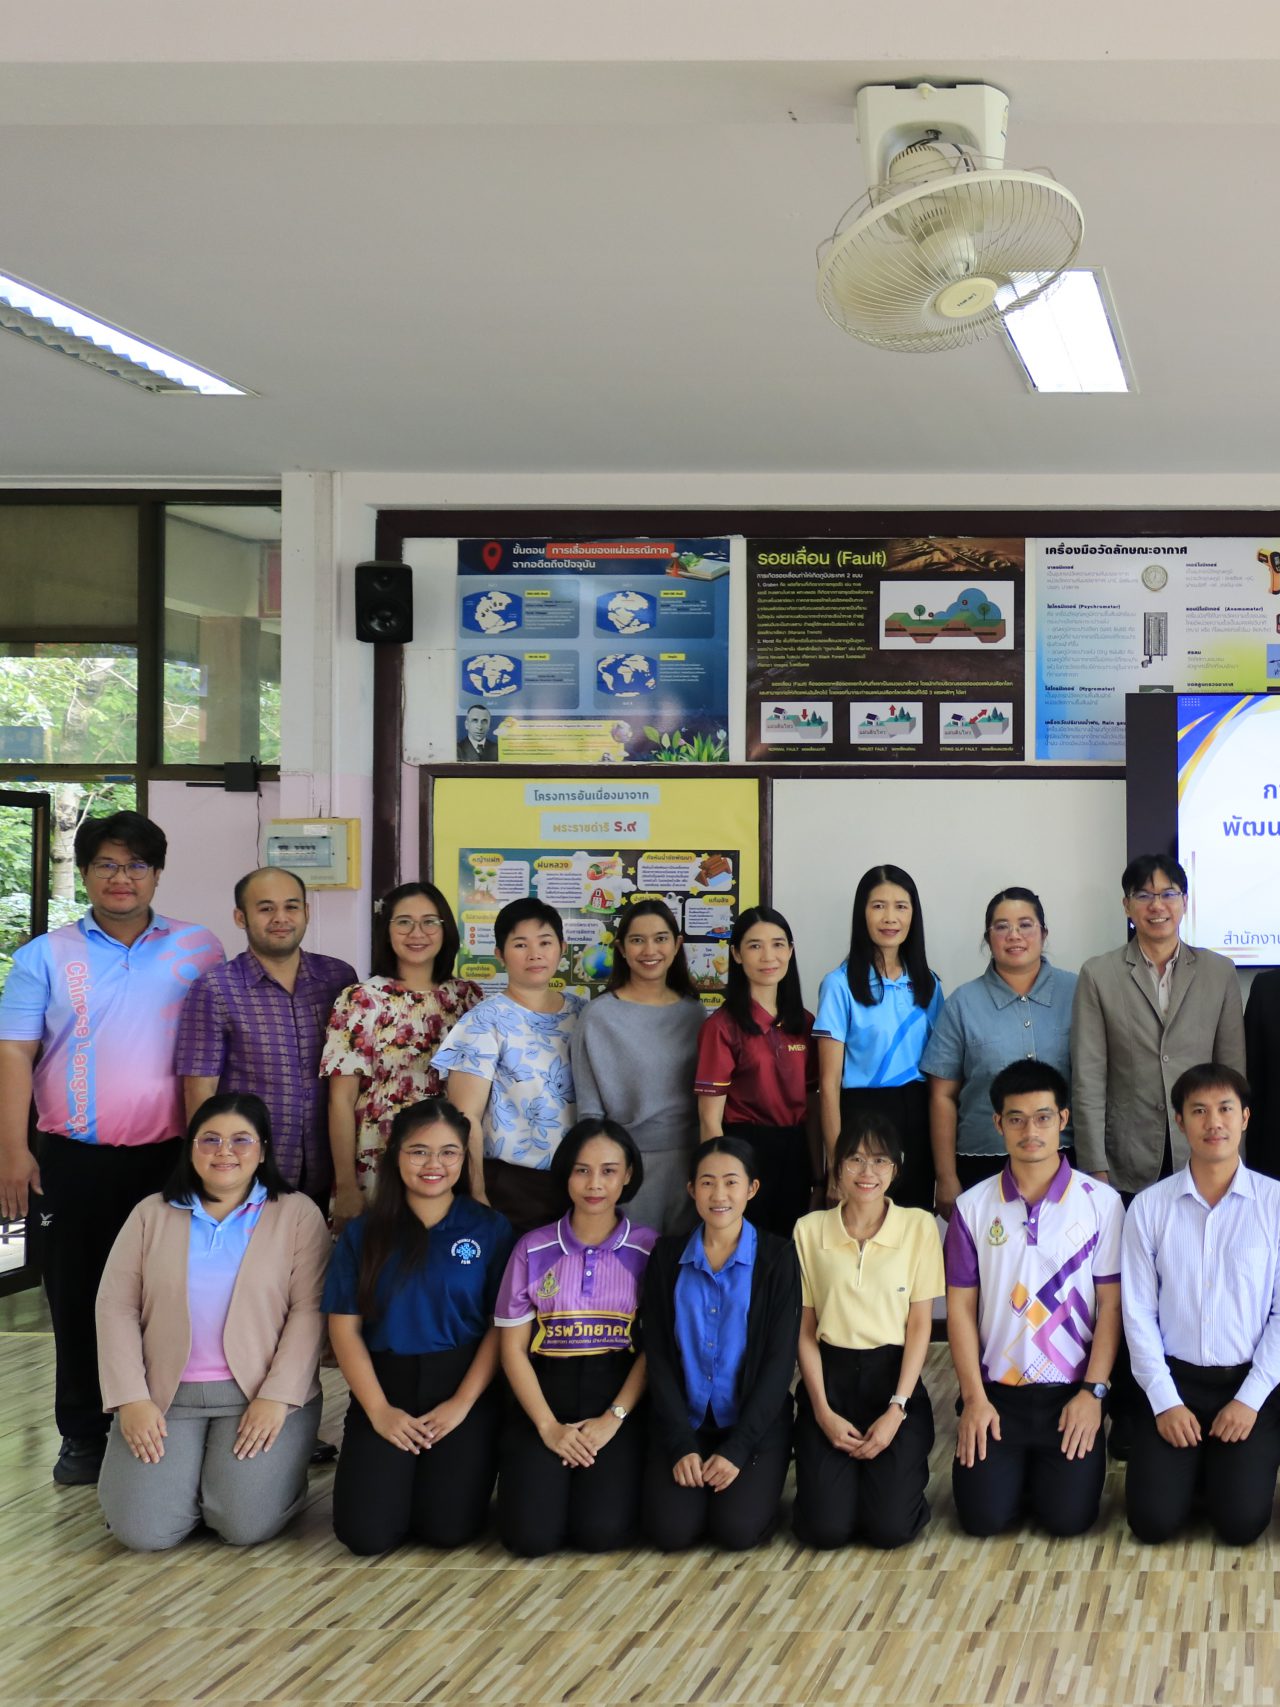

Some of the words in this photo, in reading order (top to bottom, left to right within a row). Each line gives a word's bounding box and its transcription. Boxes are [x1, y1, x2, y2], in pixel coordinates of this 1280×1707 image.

[1045, 542, 1188, 555] เครื่องมือวัดลักษณะอากาศ
[757, 546, 830, 565] รอยเลื่อน
[837, 550, 887, 568] (Fault)
[512, 559, 596, 571] จากอดีตถึงปัจจุบัน
[534, 787, 649, 801] โครงการอันเนื่องมาจาก
[553, 821, 611, 833] พระราชดำริ
[65, 961, 91, 1038] Chinese
[70, 1041, 91, 1135] Language
